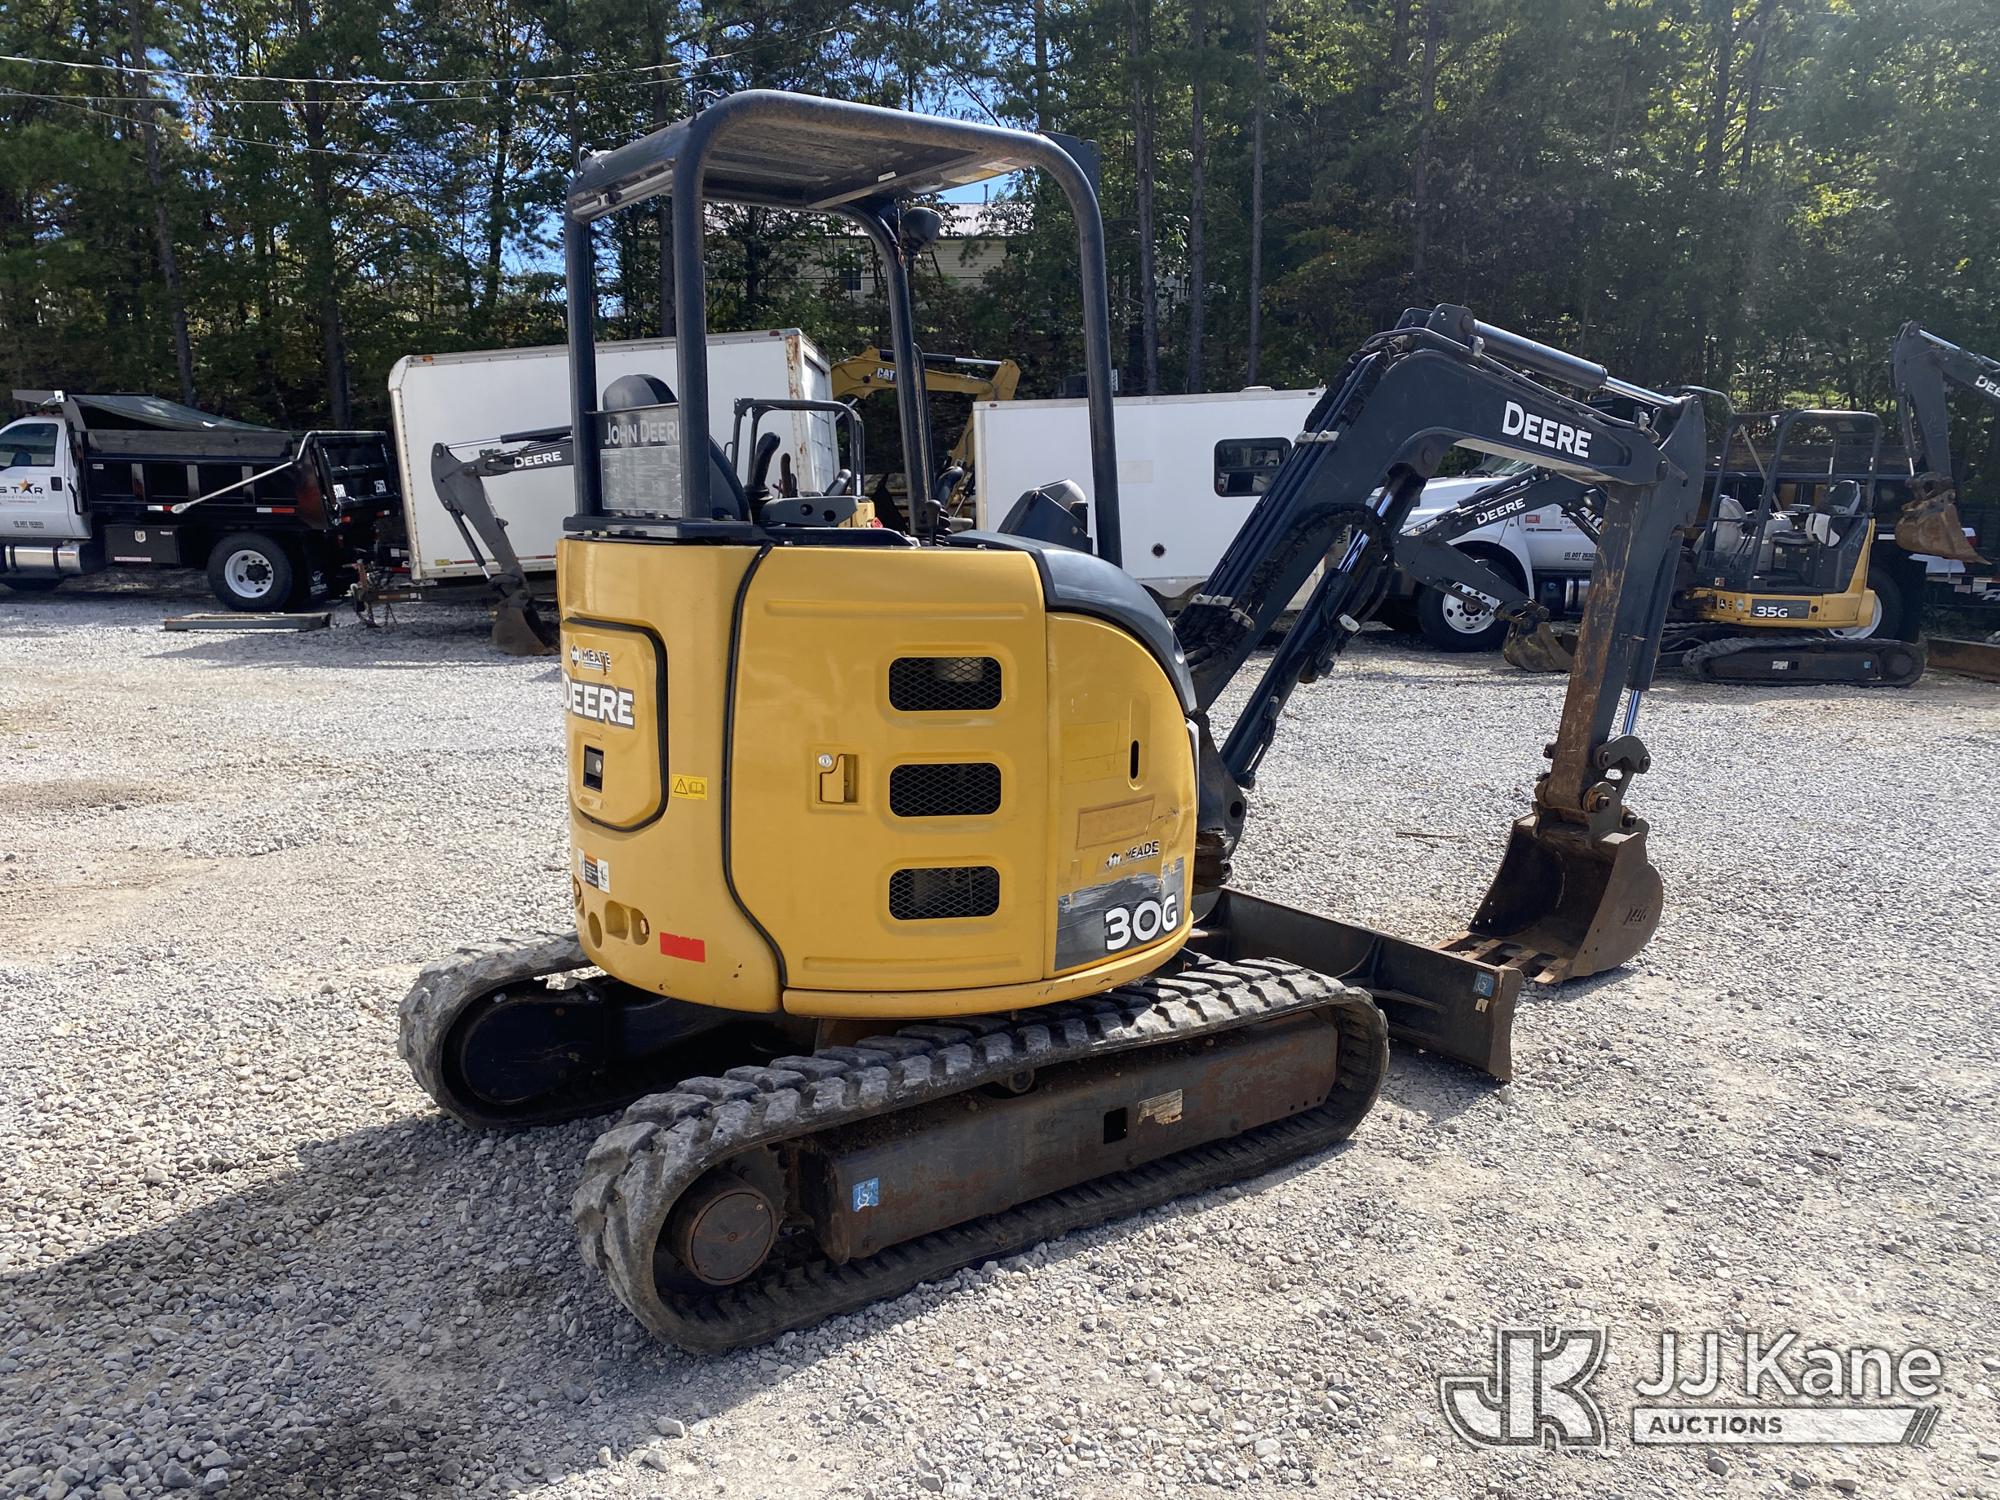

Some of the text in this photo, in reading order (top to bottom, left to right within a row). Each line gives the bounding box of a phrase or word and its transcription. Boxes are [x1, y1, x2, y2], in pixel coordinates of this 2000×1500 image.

[876, 367, 895, 381] CAT
[604, 419, 680, 445] JOHN DEER
[1501, 400, 1592, 458] DEERE
[514, 451, 562, 468] DEERE
[1475, 498, 1526, 525] DEERE
[1754, 606, 1788, 618] 35G
[1105, 894, 1178, 951] 30G
